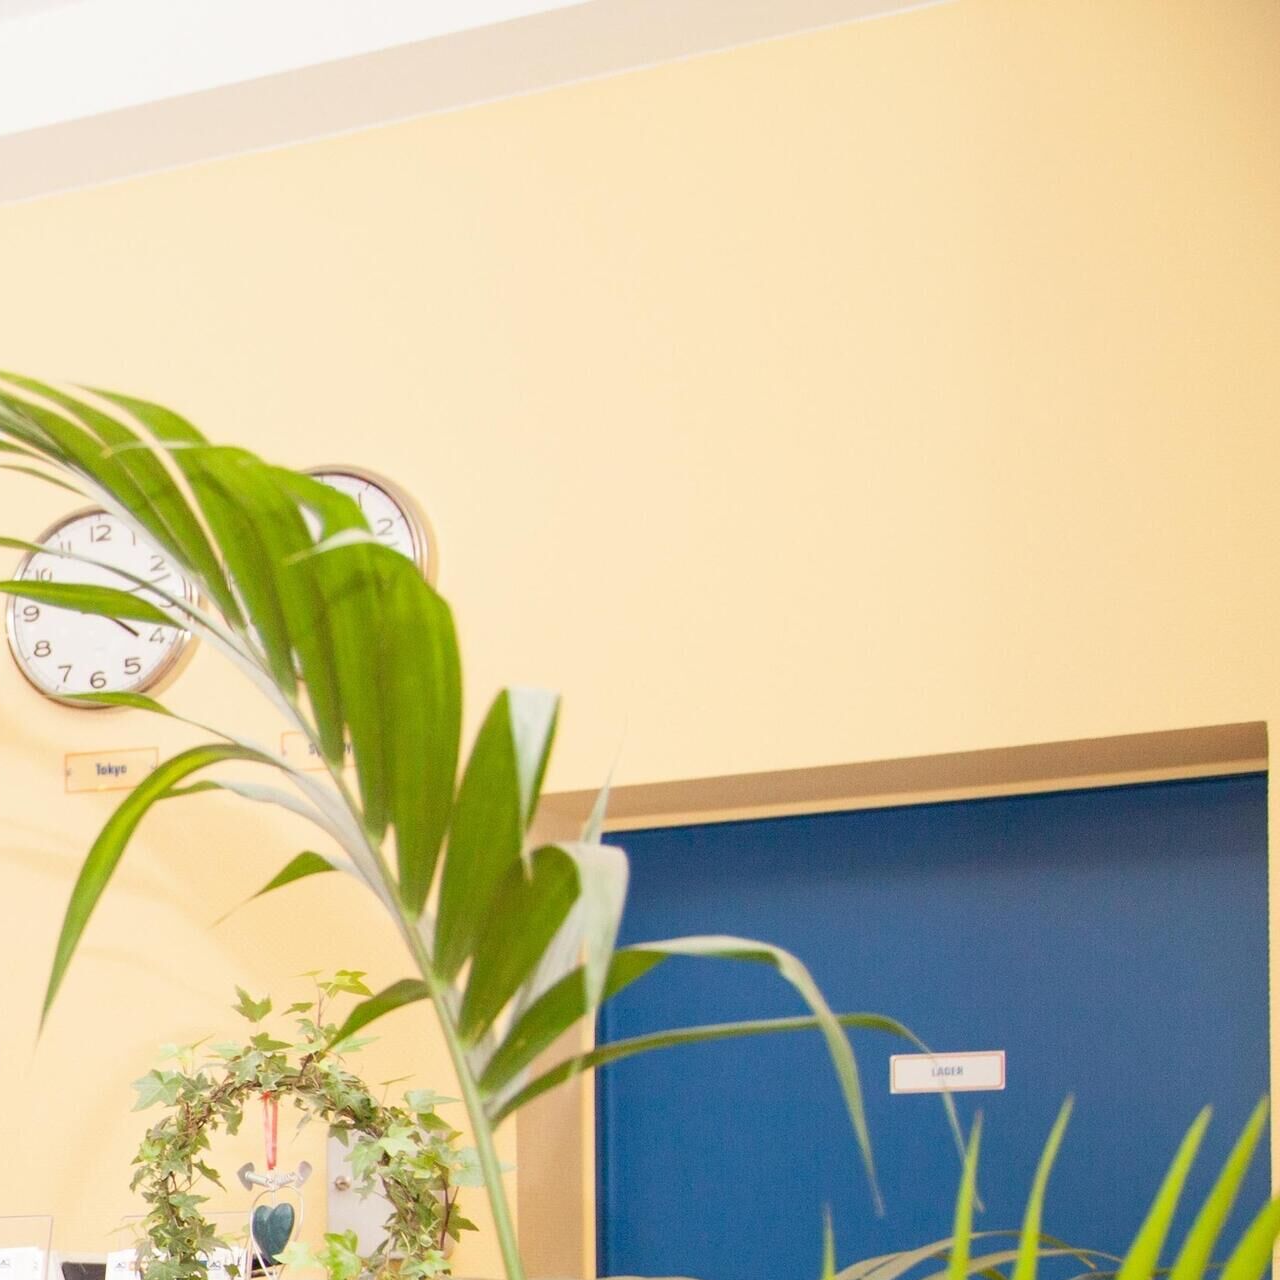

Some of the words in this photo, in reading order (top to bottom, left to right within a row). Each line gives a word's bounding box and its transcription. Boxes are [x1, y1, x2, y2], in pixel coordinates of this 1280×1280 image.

[90, 524, 112, 543] 12
[376, 518, 393, 536] 2
[150, 555, 166, 572] 2
[23, 605, 40, 622] 9
[149, 627, 165, 644] 4
[33, 640, 52, 657] 8
[57, 665, 73, 683] 7
[124, 657, 141, 675] 5
[90, 671, 107, 689] 6
[96, 763, 127, 777] Tokyo
[931, 1066, 964, 1077] LAGER
